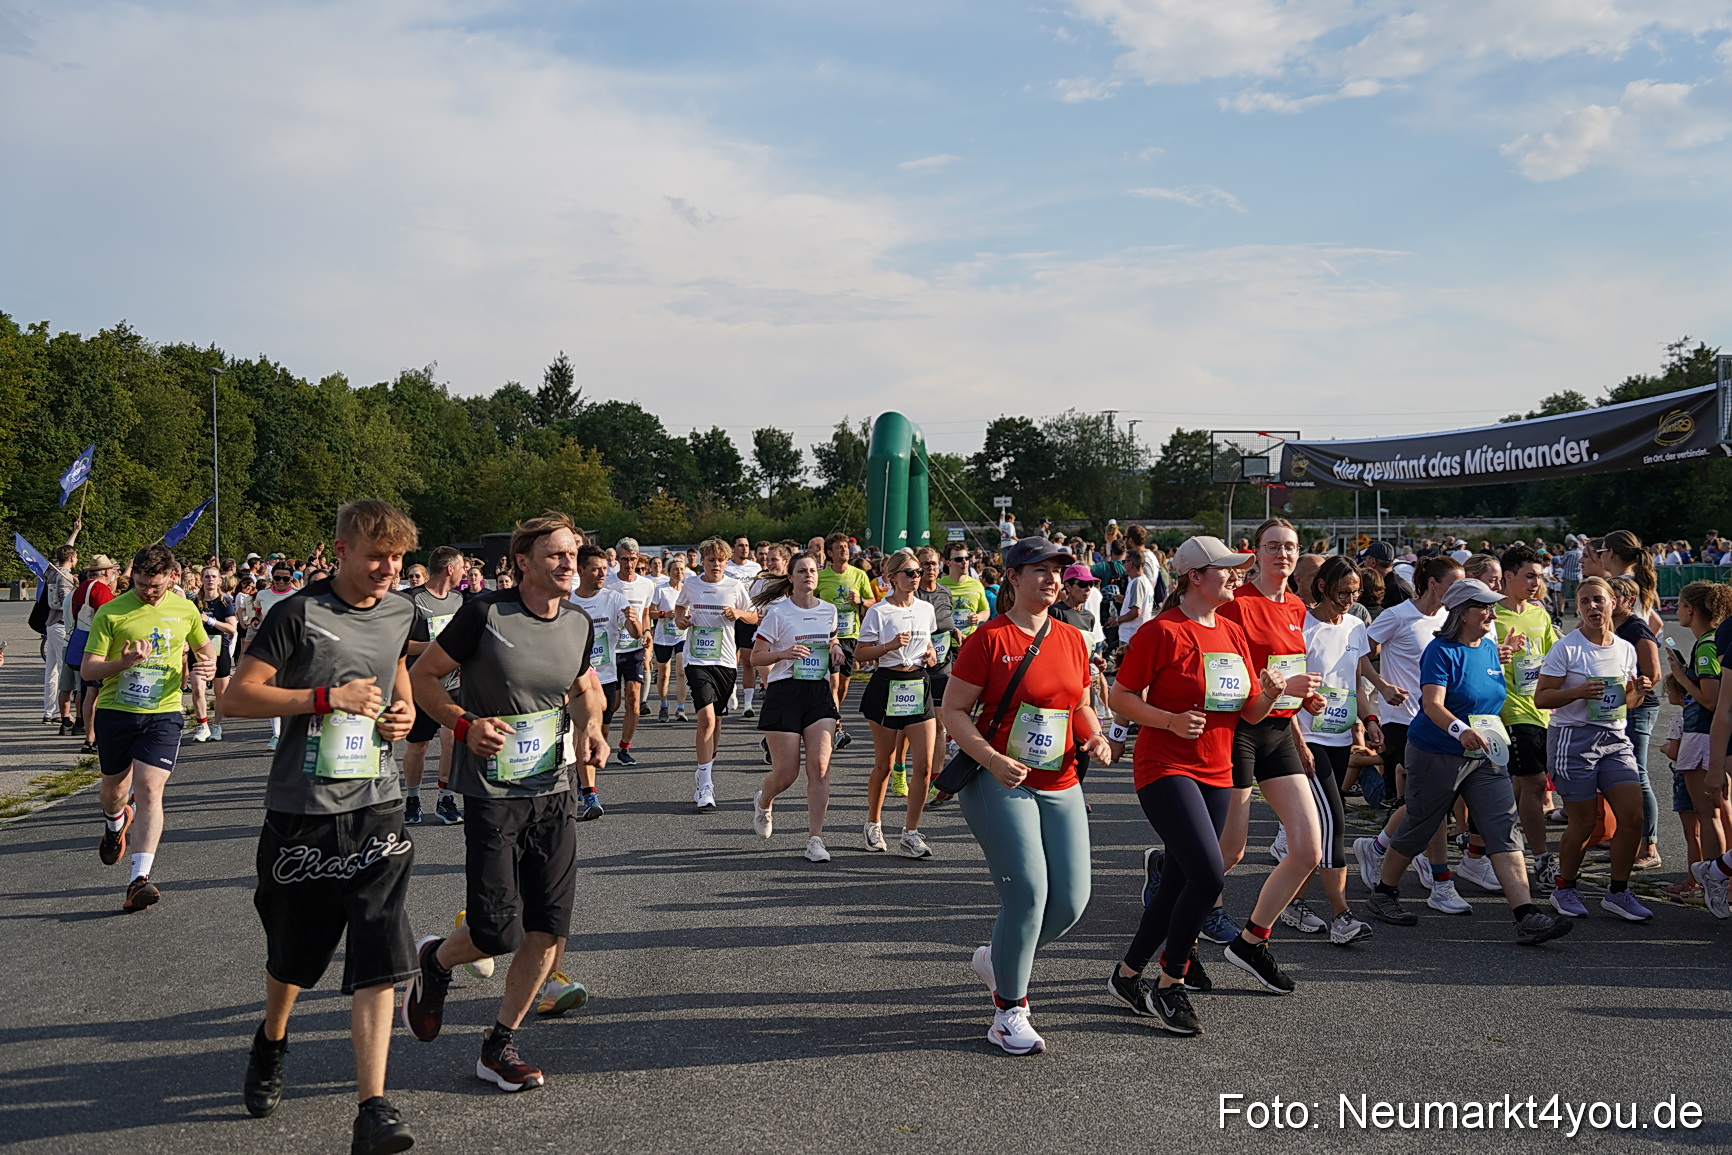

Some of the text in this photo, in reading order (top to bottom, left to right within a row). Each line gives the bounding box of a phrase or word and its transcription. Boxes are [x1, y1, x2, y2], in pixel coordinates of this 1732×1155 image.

[1332, 435, 1600, 487] Hier gewinnt das Miteinander.
[1643, 454, 1653, 464] Ein
[1665, 452, 1677, 461] der
[696, 638, 715, 647] 1902
[802, 658, 820, 667] 1901
[1524, 671, 1539, 680] 228
[128, 682, 150, 694] 226
[1219, 676, 1240, 689] 782
[895, 694, 916, 703] 1900
[1323, 706, 1348, 719] 1429
[345, 735, 364, 750] 161
[1026, 731, 1053, 748] 785
[517, 738, 540, 754] 178
[1028, 746, 1039, 755] Eva
[509, 755, 530, 764] Roland
